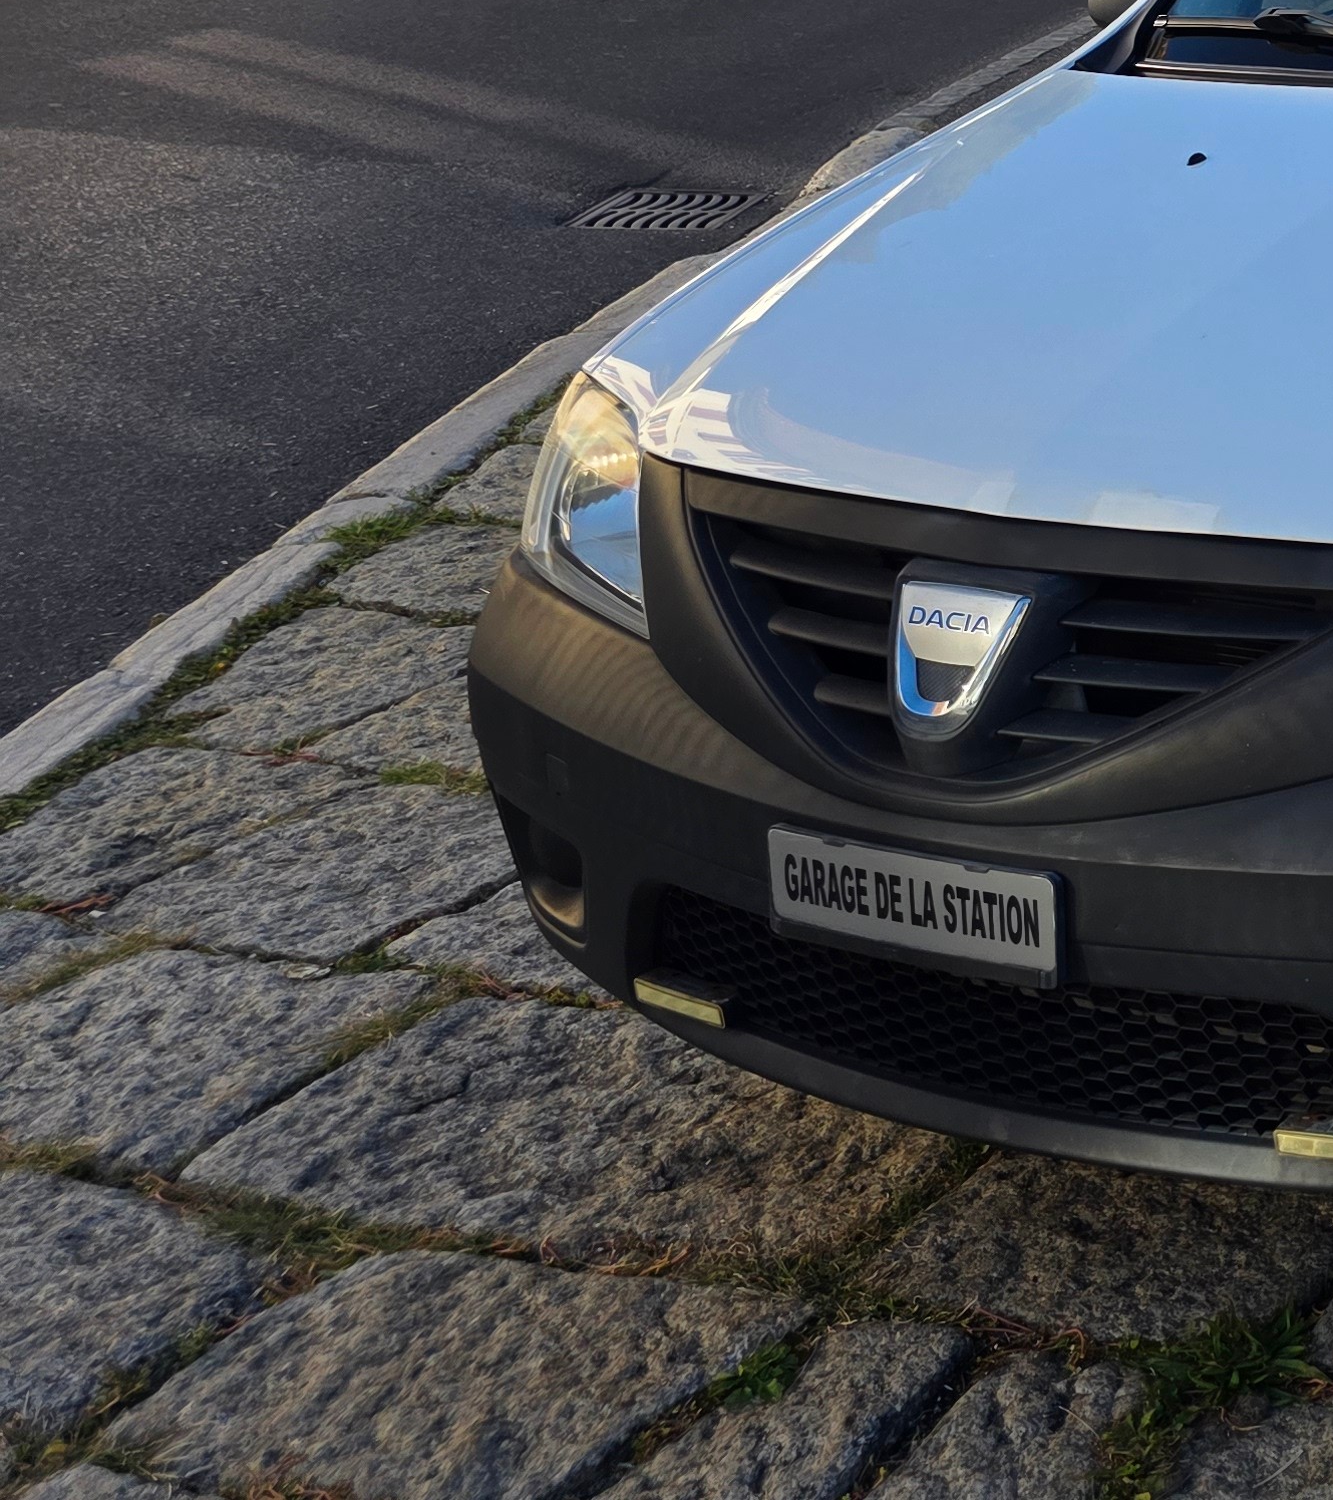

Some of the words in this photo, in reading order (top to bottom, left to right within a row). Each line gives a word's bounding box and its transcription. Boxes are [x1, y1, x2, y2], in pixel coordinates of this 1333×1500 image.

[908, 605, 992, 636] DACIA
[784, 853, 870, 916] GARAGE
[875, 871, 904, 923] DE
[909, 877, 938, 930] LA
[943, 883, 1040, 948] STATION
